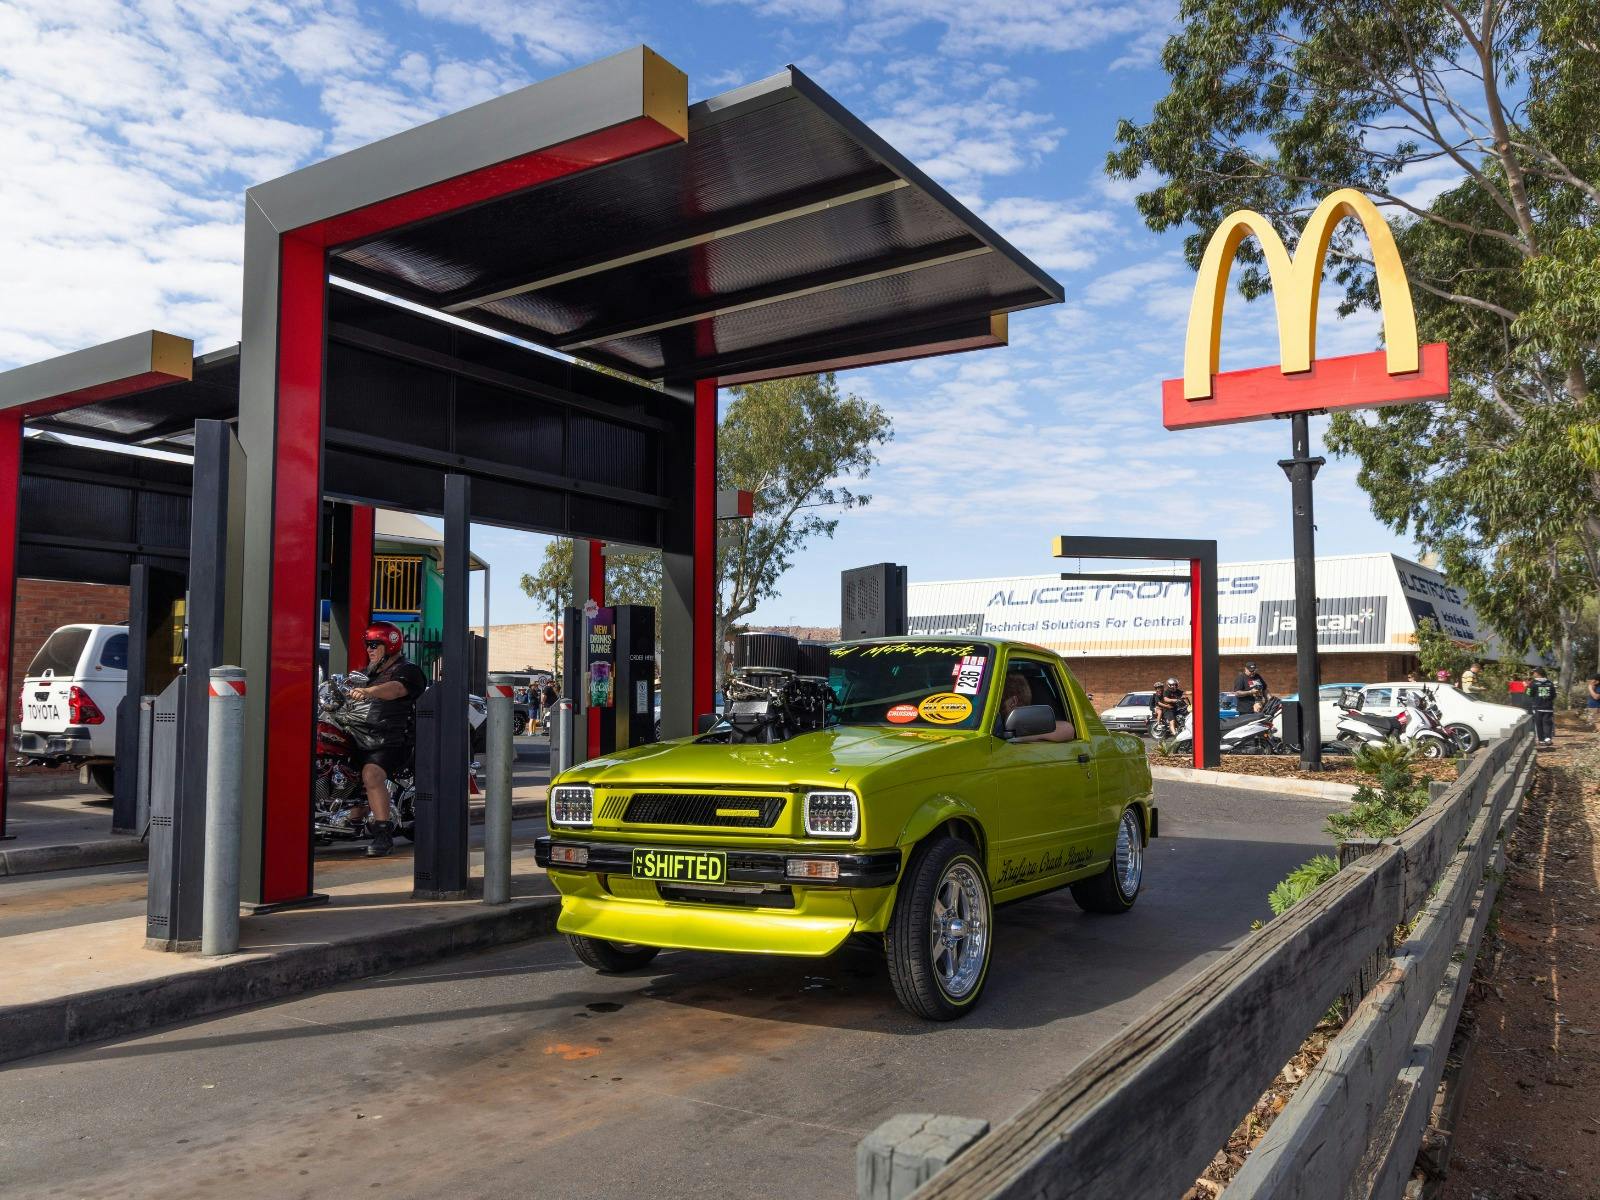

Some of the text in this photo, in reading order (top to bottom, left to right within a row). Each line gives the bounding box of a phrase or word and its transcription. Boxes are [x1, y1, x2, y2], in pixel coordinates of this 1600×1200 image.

[987, 576, 1260, 606] ALICETRONCS
[593, 625, 608, 635] NEW
[984, 620, 1038, 633] Technical
[1042, 618, 1100, 631] Solutions
[1105, 616, 1128, 628] For
[1133, 615, 1185, 627] Central
[1269, 609, 1359, 636] jacar
[589, 634, 612, 644] DRINKS
[590, 643, 612, 654] RANGE
[957, 669, 981, 690] 236
[28, 704, 60, 720] TOYOTA
[644, 852, 722, 881] SHIFTED
